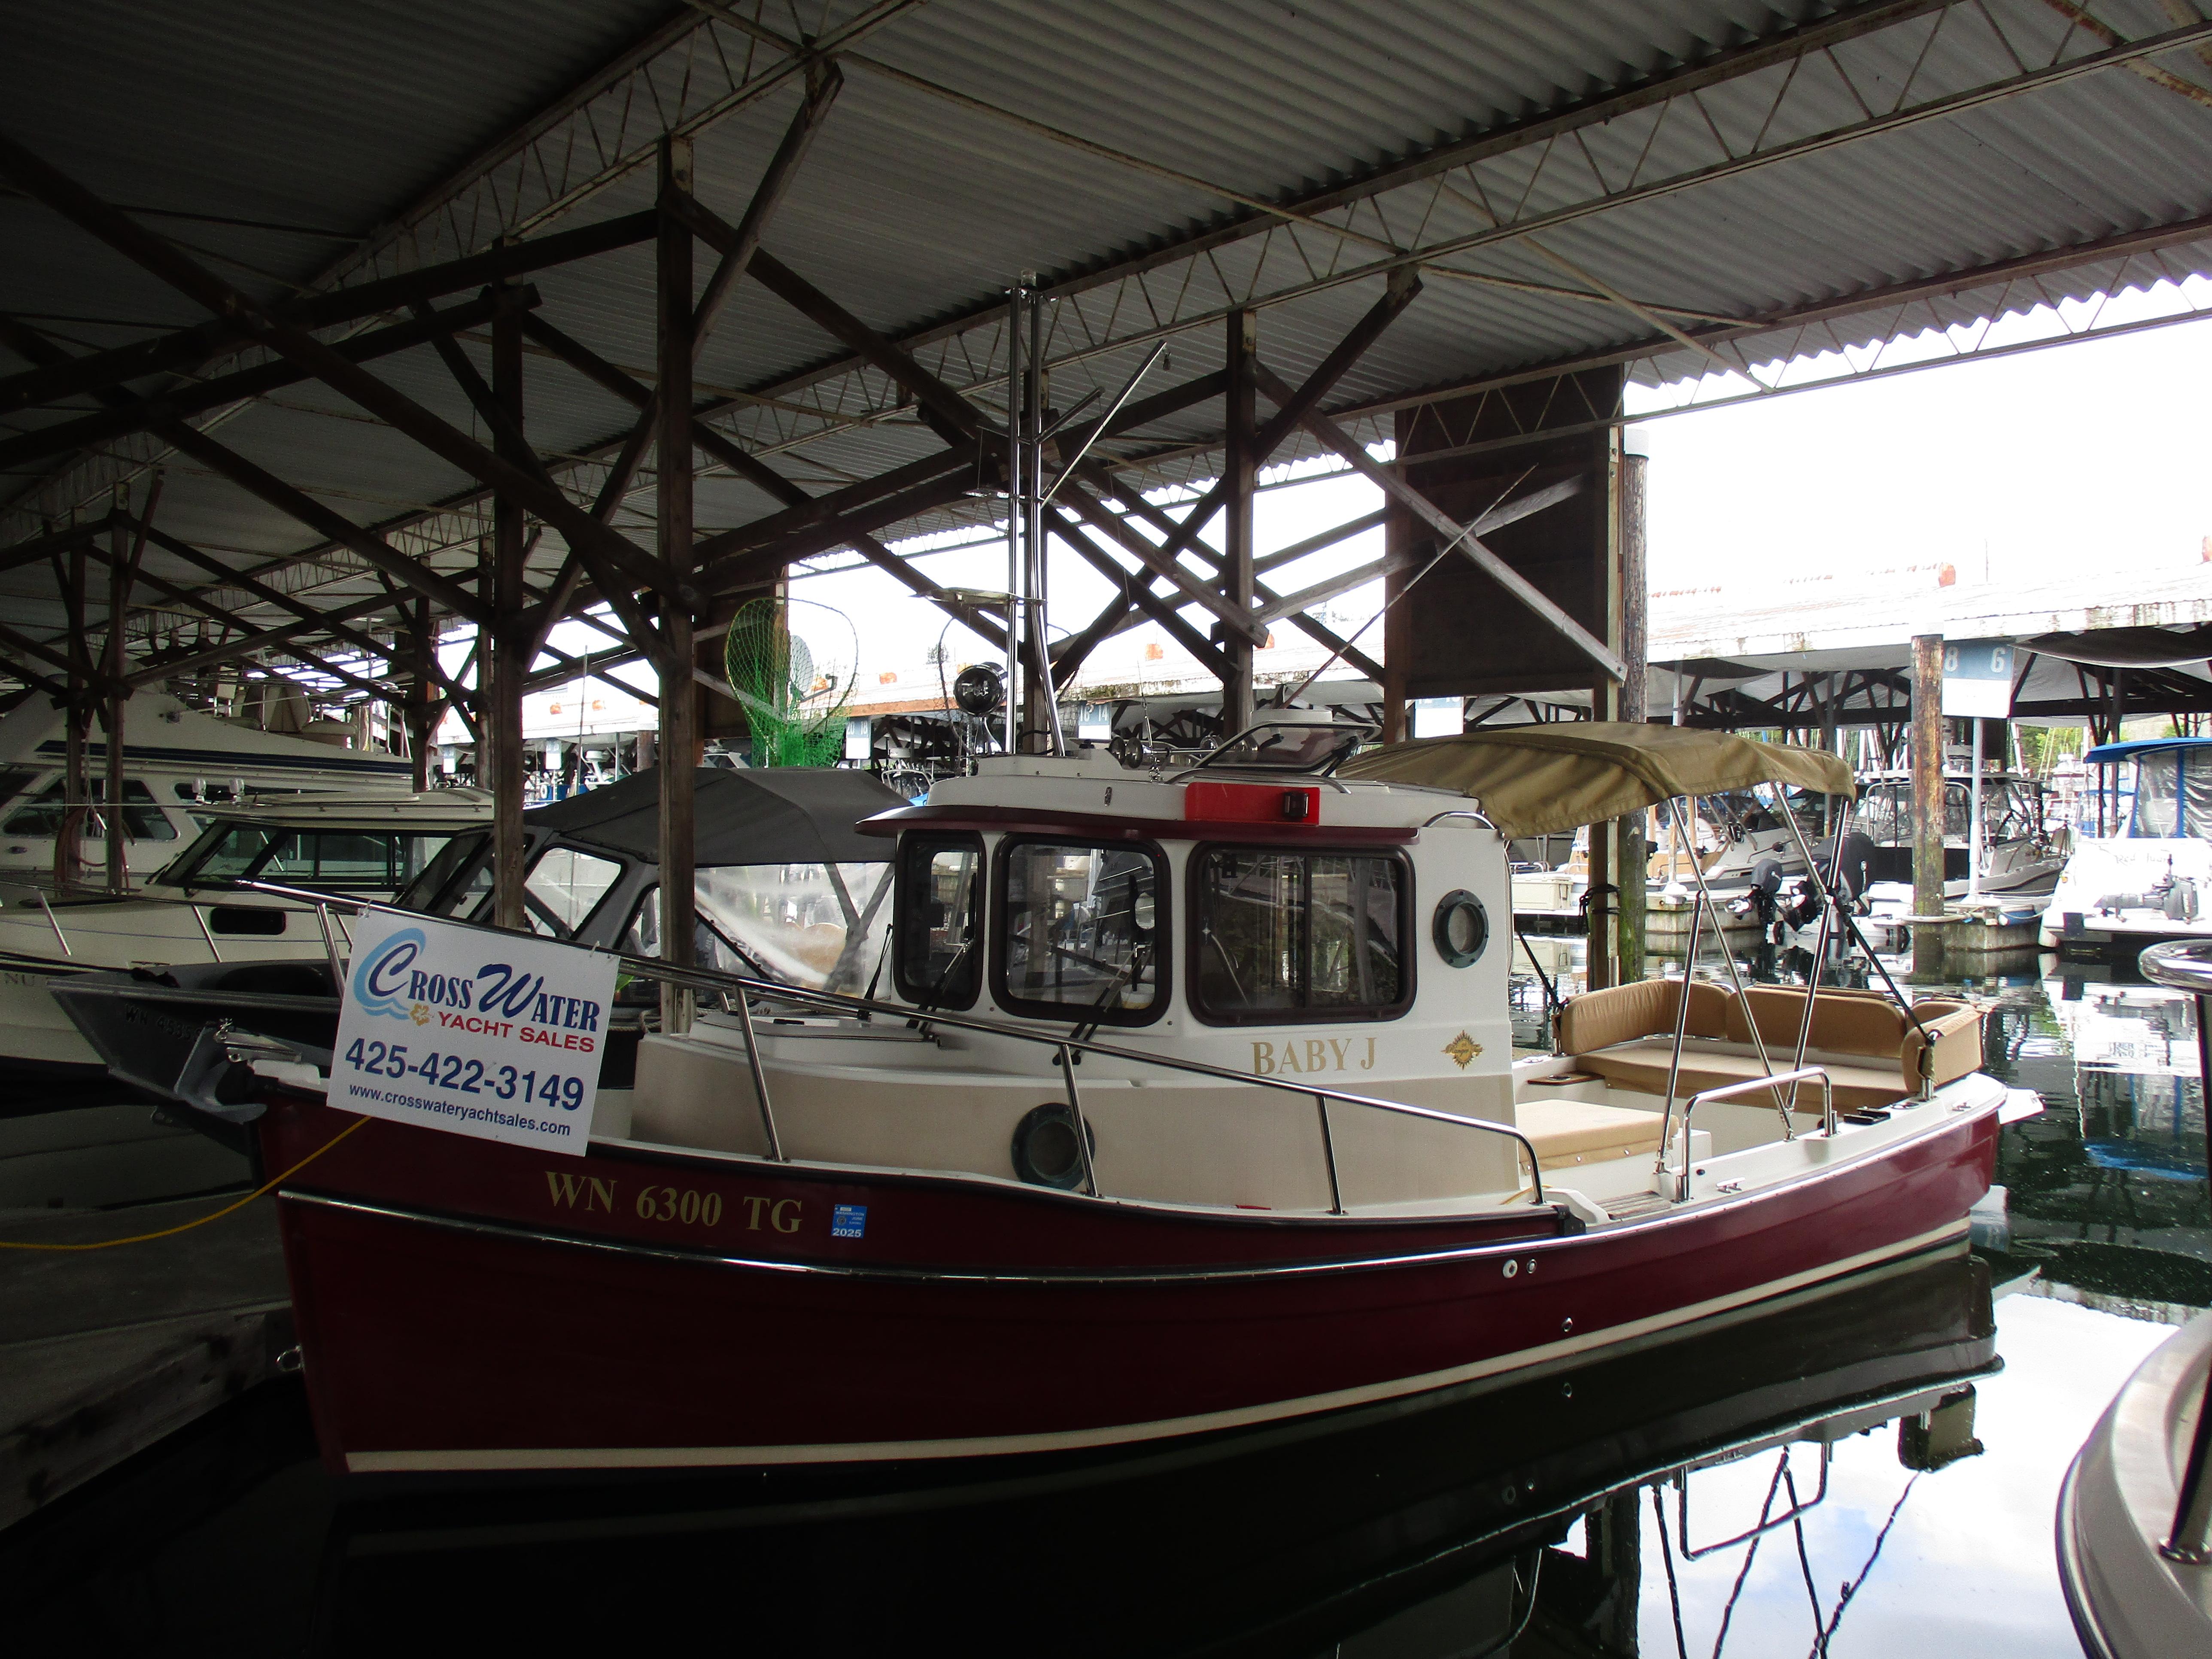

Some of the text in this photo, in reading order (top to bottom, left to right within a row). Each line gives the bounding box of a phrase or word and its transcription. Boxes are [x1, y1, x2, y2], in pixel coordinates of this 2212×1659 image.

[1944, 647, 2005, 673] 8 6
[861, 721, 868, 735] 18
[1099, 705, 1109, 722] 14
[437, 1011, 595, 1053] YACHT SALES
[345, 1037, 584, 1111] 425-422-3149
[1250, 1037, 1377, 1075] BABY J
[349, 1083, 570, 1136] www.crosswateryachtsales.com
[545, 1171, 803, 1234] WN 6300 TG
[833, 1228, 861, 1237] 2025
